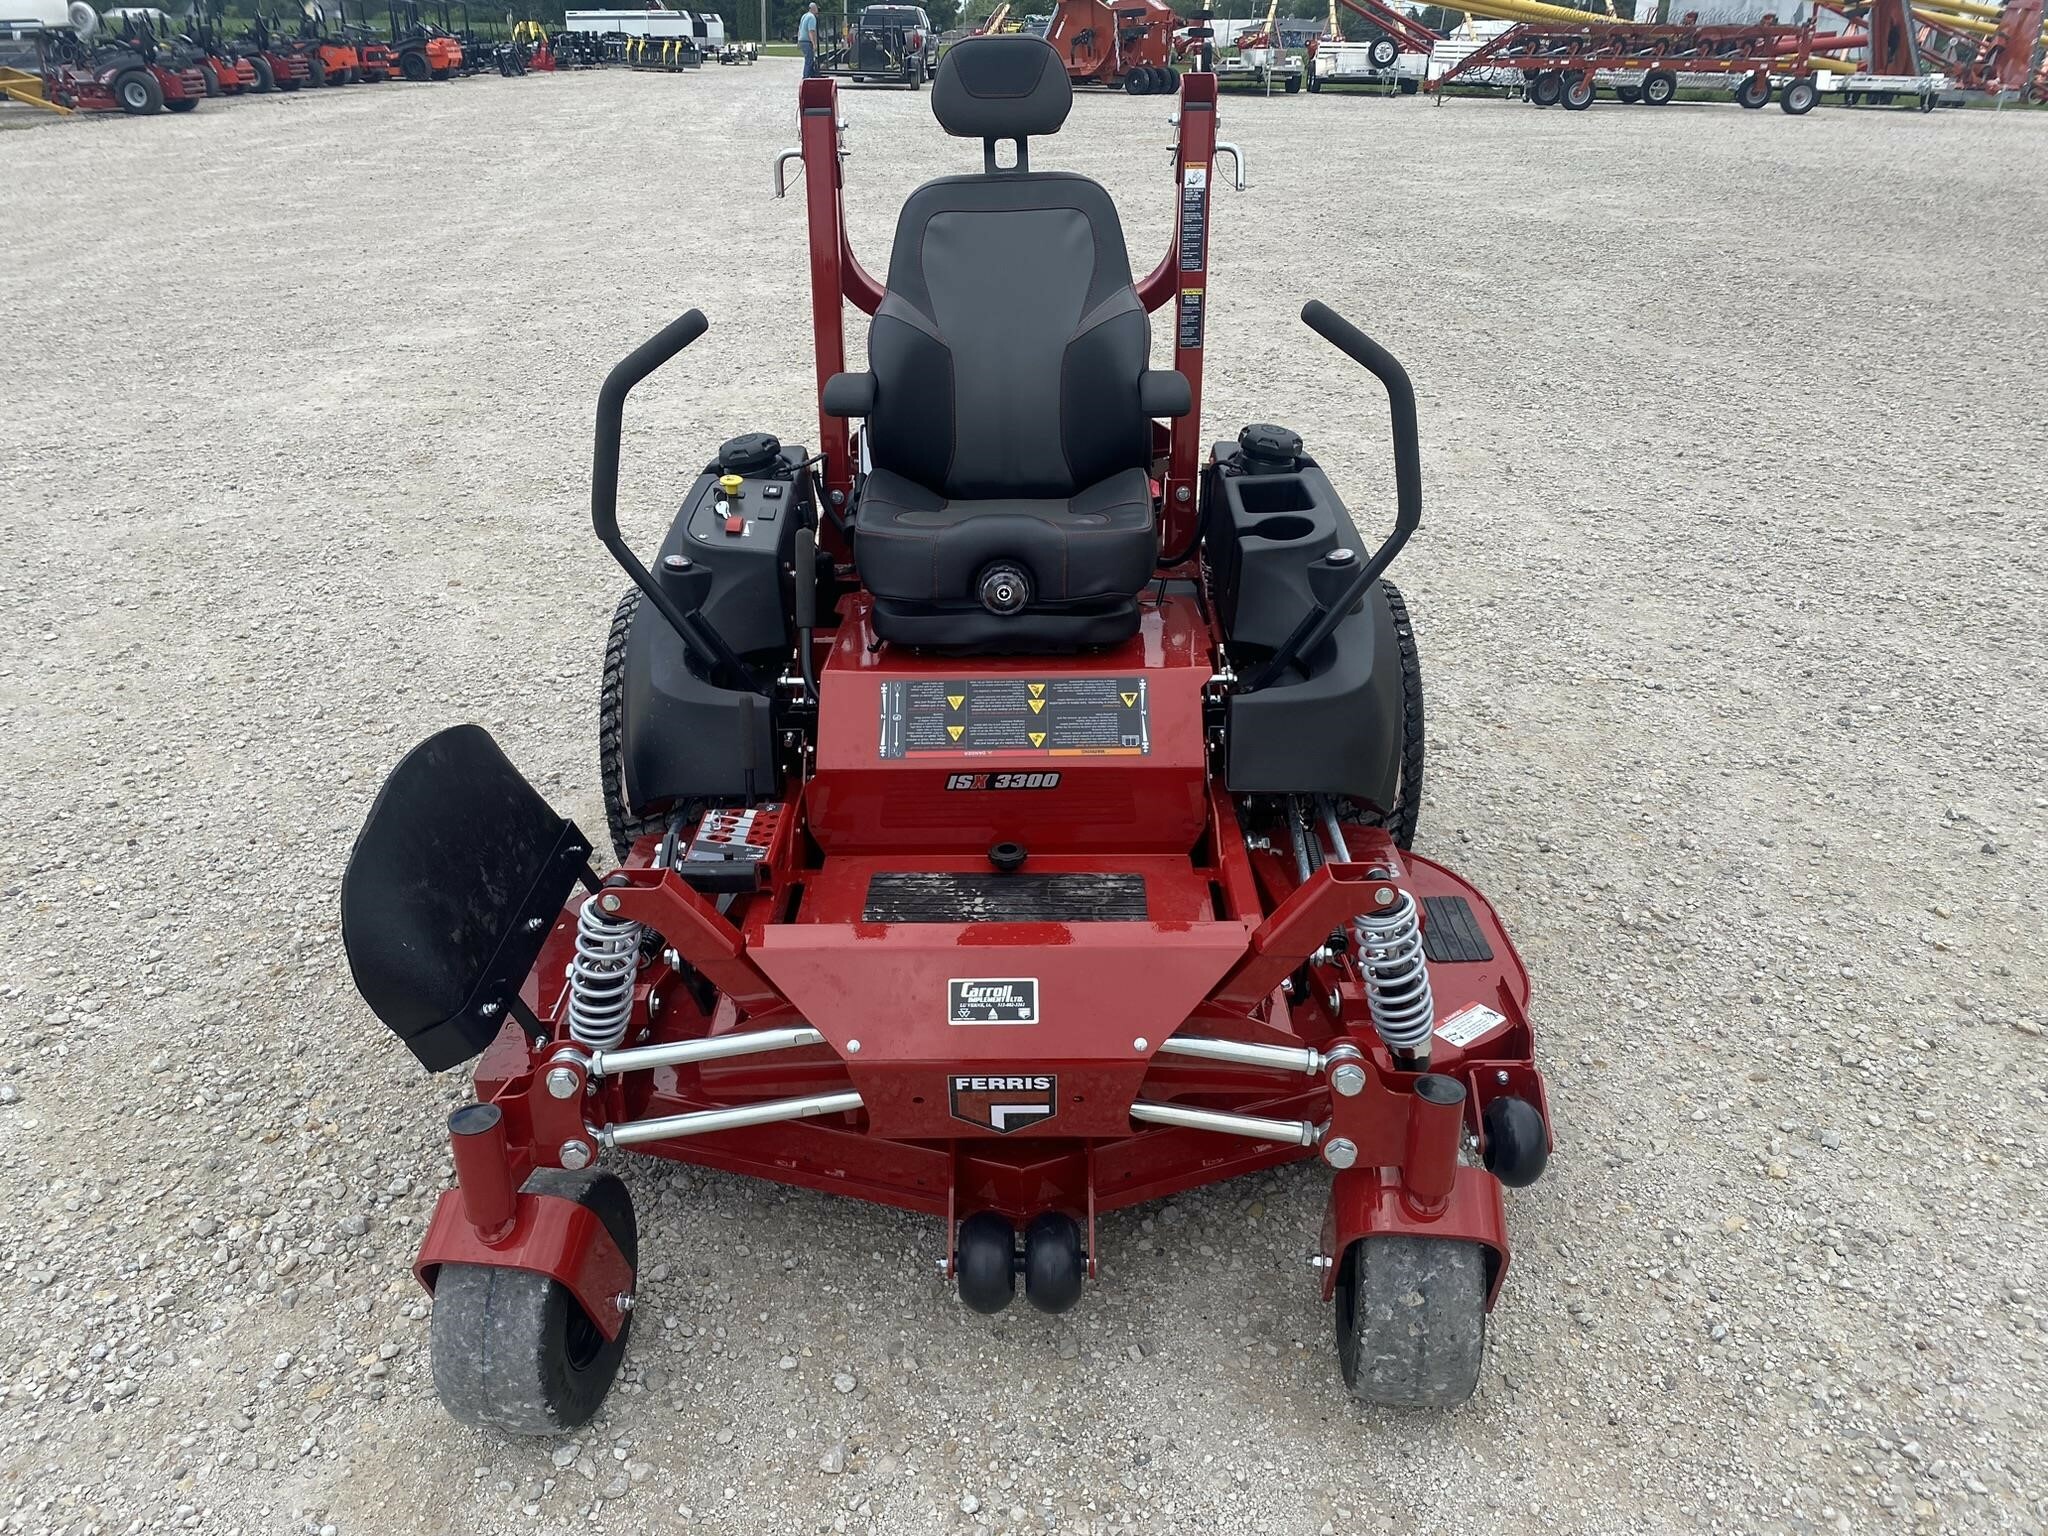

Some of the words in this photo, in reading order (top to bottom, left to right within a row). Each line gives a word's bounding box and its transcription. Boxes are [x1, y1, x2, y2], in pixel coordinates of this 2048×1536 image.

[947, 774, 990, 789] ISX
[994, 773, 1060, 788] 3300
[960, 982, 1013, 1003] Carroll
[955, 1077, 1051, 1090] FERRIS
